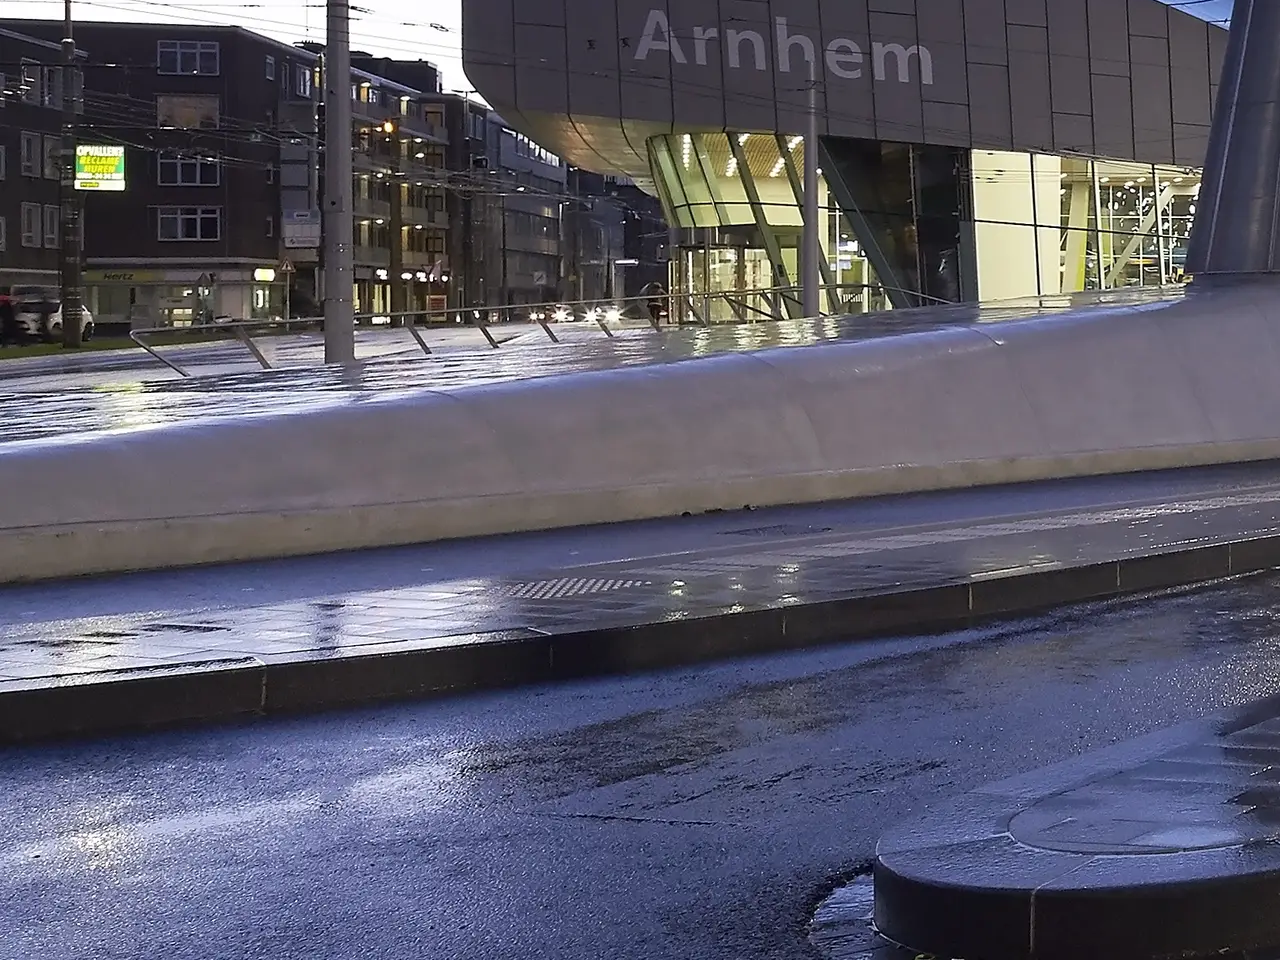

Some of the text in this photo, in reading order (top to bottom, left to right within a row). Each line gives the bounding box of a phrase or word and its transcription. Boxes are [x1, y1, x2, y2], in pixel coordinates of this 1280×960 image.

[633, 9, 934, 85] Arnhem
[79, 156, 120, 165] RECLAME
[83, 164, 116, 173] HUREN
[103, 272, 134, 281] Hertz
